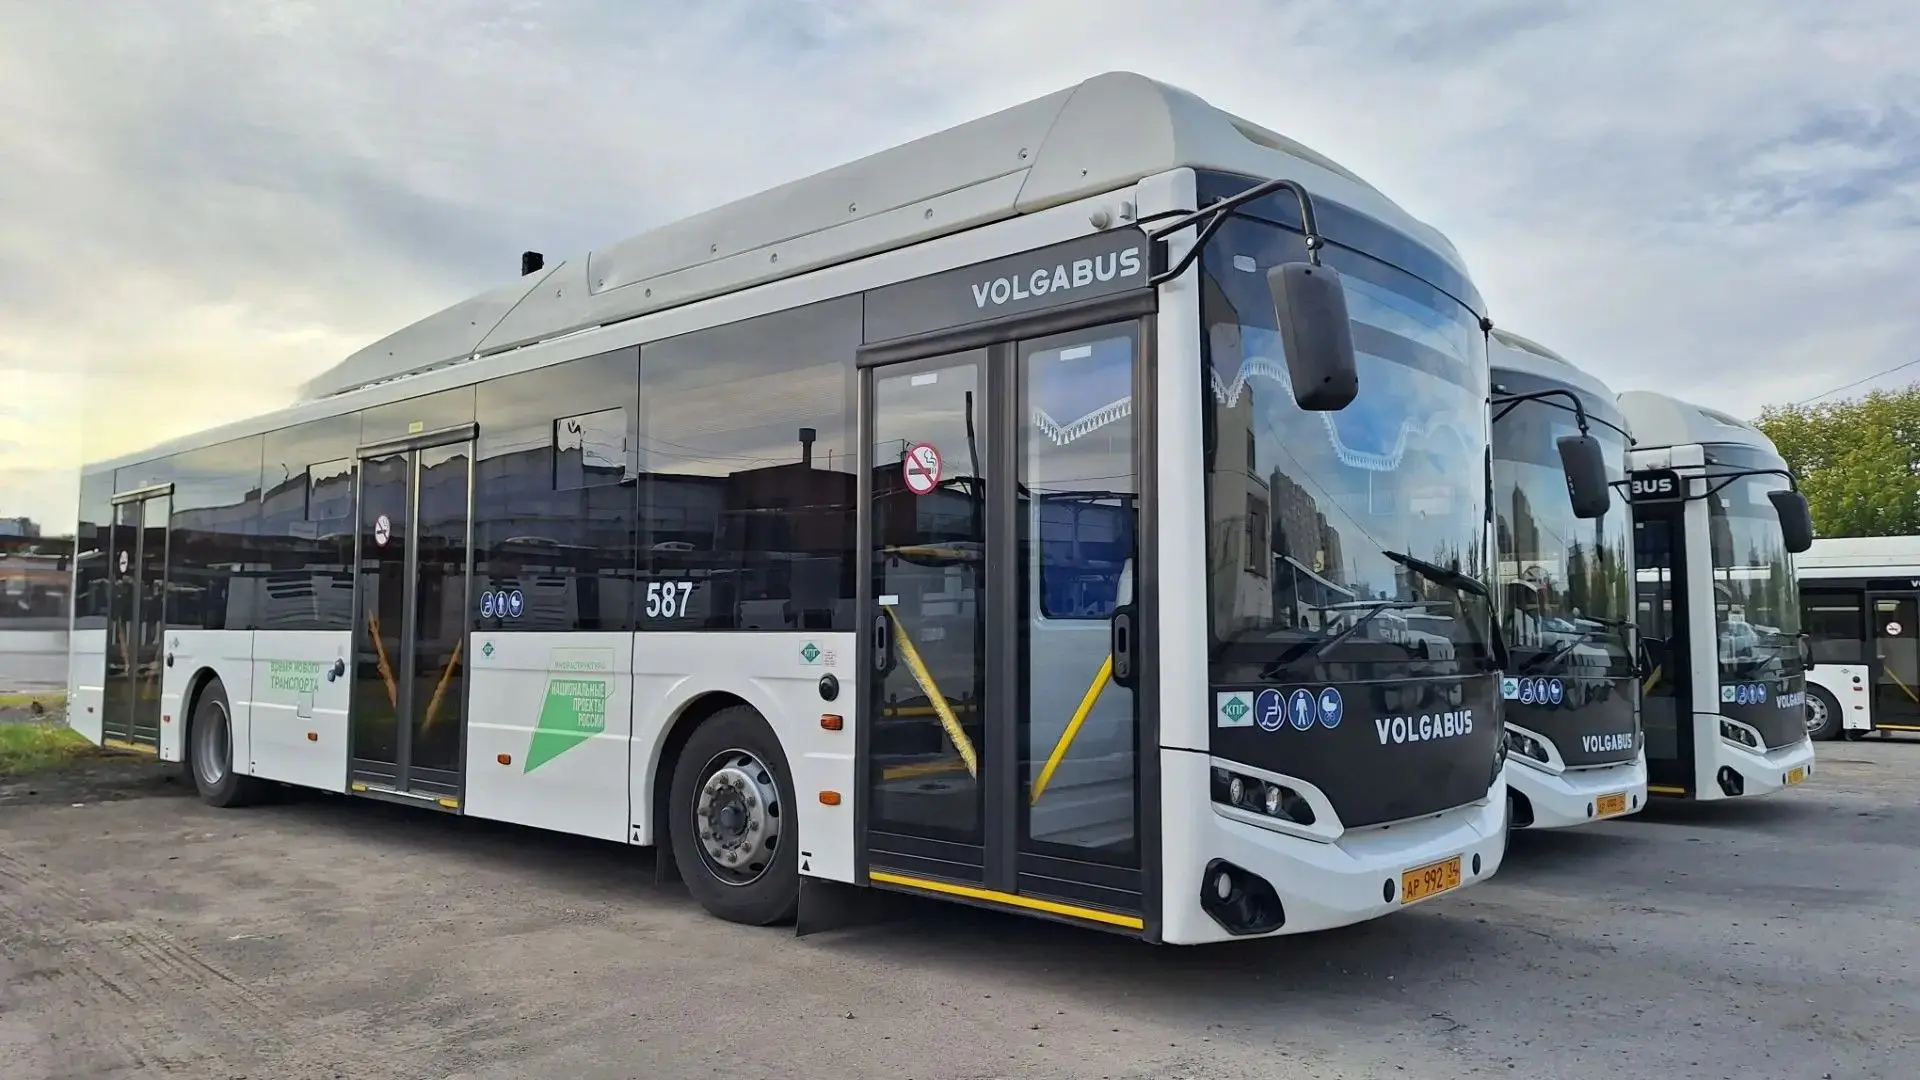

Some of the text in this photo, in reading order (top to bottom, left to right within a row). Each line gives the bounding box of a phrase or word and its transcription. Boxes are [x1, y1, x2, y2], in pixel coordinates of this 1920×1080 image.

[971, 247, 1141, 308] VOLGABUS
[646, 581, 693, 618] 587
[271, 675, 319, 693] ТРАНСПОРТА
[551, 682, 605, 698] НАЦИОНАЛЬНЫЕ
[572, 698, 605, 713] ПРОЕКТЫ
[1226, 704, 1245, 716] КПГ
[578, 712, 605, 728] РОССИИ
[1375, 709, 1473, 745] VOLGABUS
[1582, 733, 1633, 753] VOLGABUS
[1424, 867, 1443, 892] 992
